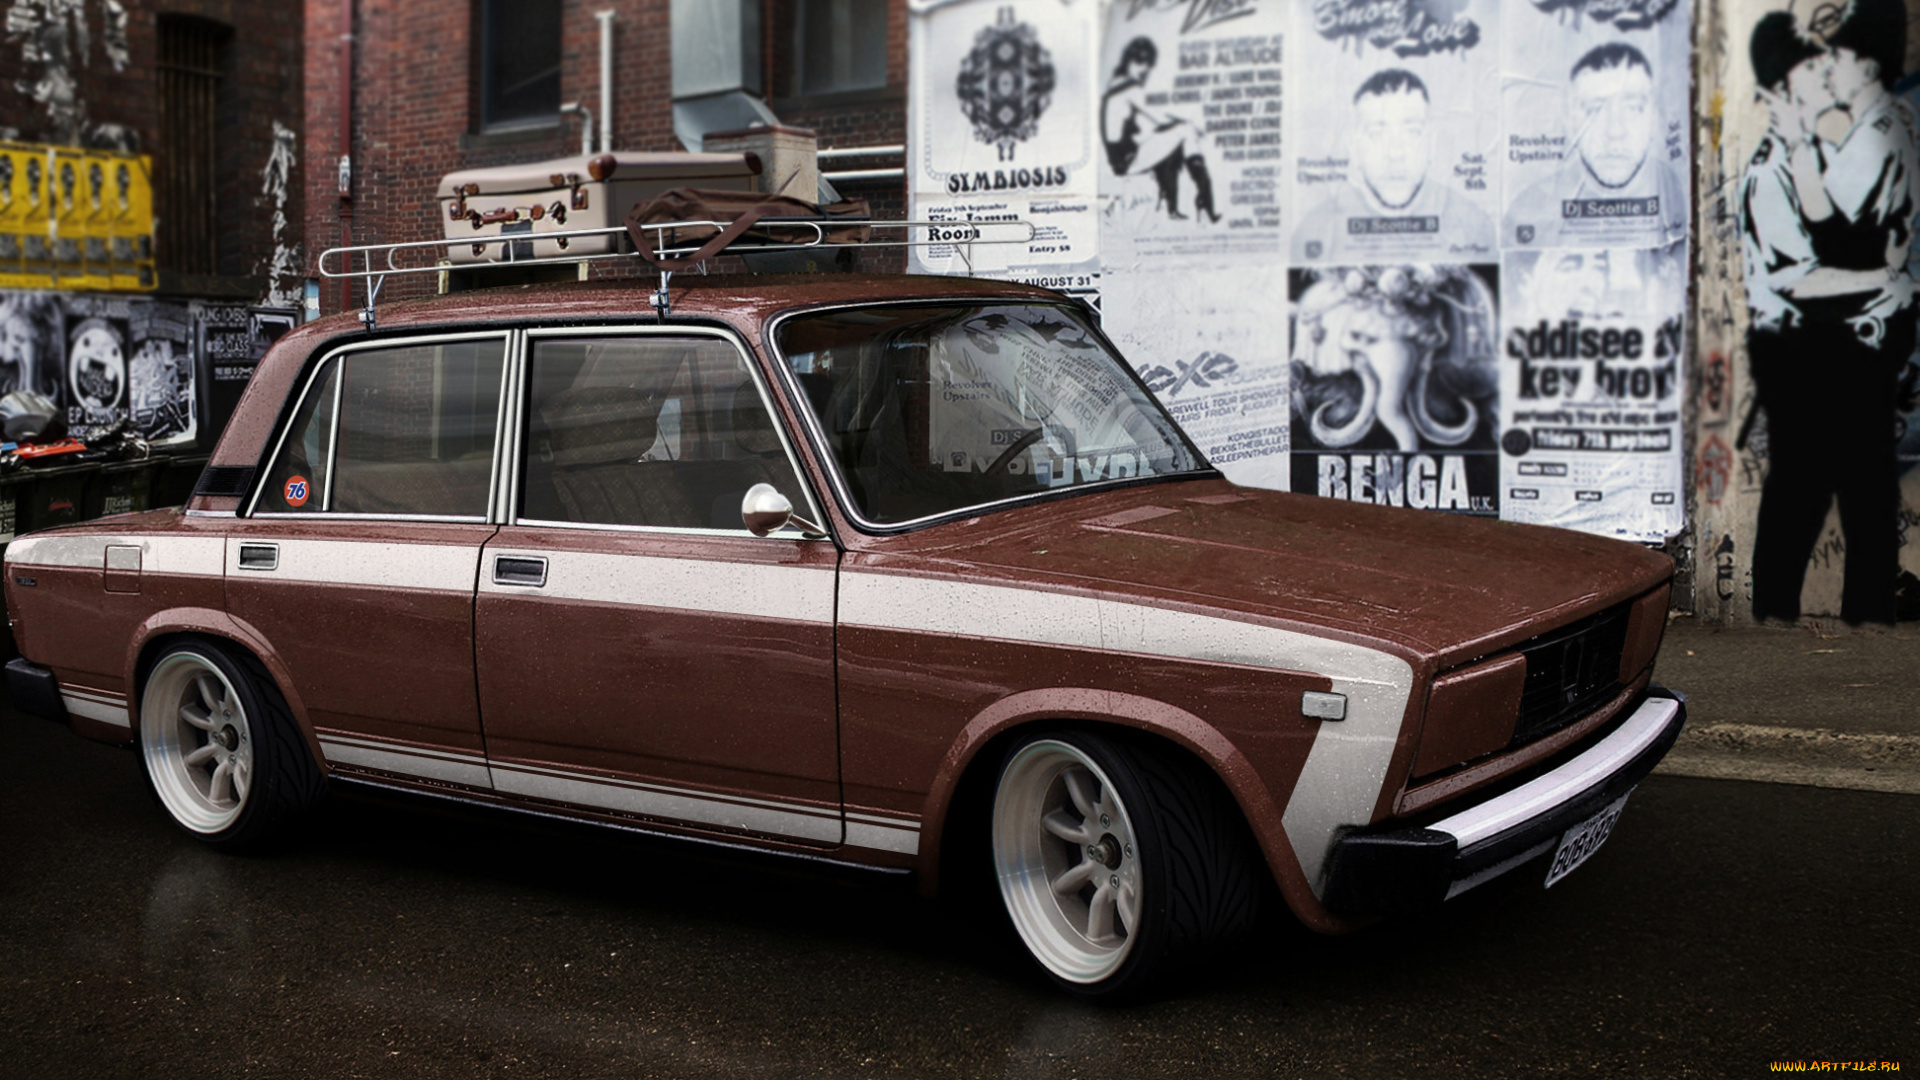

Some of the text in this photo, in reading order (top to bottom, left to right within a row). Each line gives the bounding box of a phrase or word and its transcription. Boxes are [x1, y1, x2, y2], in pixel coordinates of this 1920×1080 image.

[1179, 47, 1282, 69] BAR ALTITUDE
[1245, 84, 1282, 98] YOUNG
[1206, 119, 1246, 132] DARREN
[1215, 132, 1281, 147] PETER JAMES
[1509, 134, 1566, 147] Revolver
[1223, 149, 1281, 161] PLUS GUESTS
[1462, 153, 1486, 164] Sat.
[1509, 150, 1563, 163] Upstairs
[1297, 156, 1350, 168] Revolver
[1297, 172, 1347, 184] Upstairs
[1454, 166, 1486, 177] Sept.
[949, 166, 1067, 193] SYMBIOSIS
[1465, 178, 1486, 190] 8th
[928, 206, 952, 214] Friday
[969, 203, 1008, 212] September
[1587, 201, 1641, 215] Scottie
[1647, 200, 1658, 213] B
[1371, 218, 1421, 232] Scottie
[1426, 217, 1437, 230] B
[928, 227, 980, 242] Room
[1029, 245, 1058, 254] Entry
[1024, 276, 1091, 287] AUGUST 31
[1507, 319, 1643, 360] oddisee
[943, 380, 992, 390] Revolver
[943, 391, 990, 403] Upstairs
[1212, 394, 1238, 407] TOUR
[68, 407, 81, 423] EP
[1205, 406, 1237, 419] FRIDAY
[287, 481, 306, 500] 76
